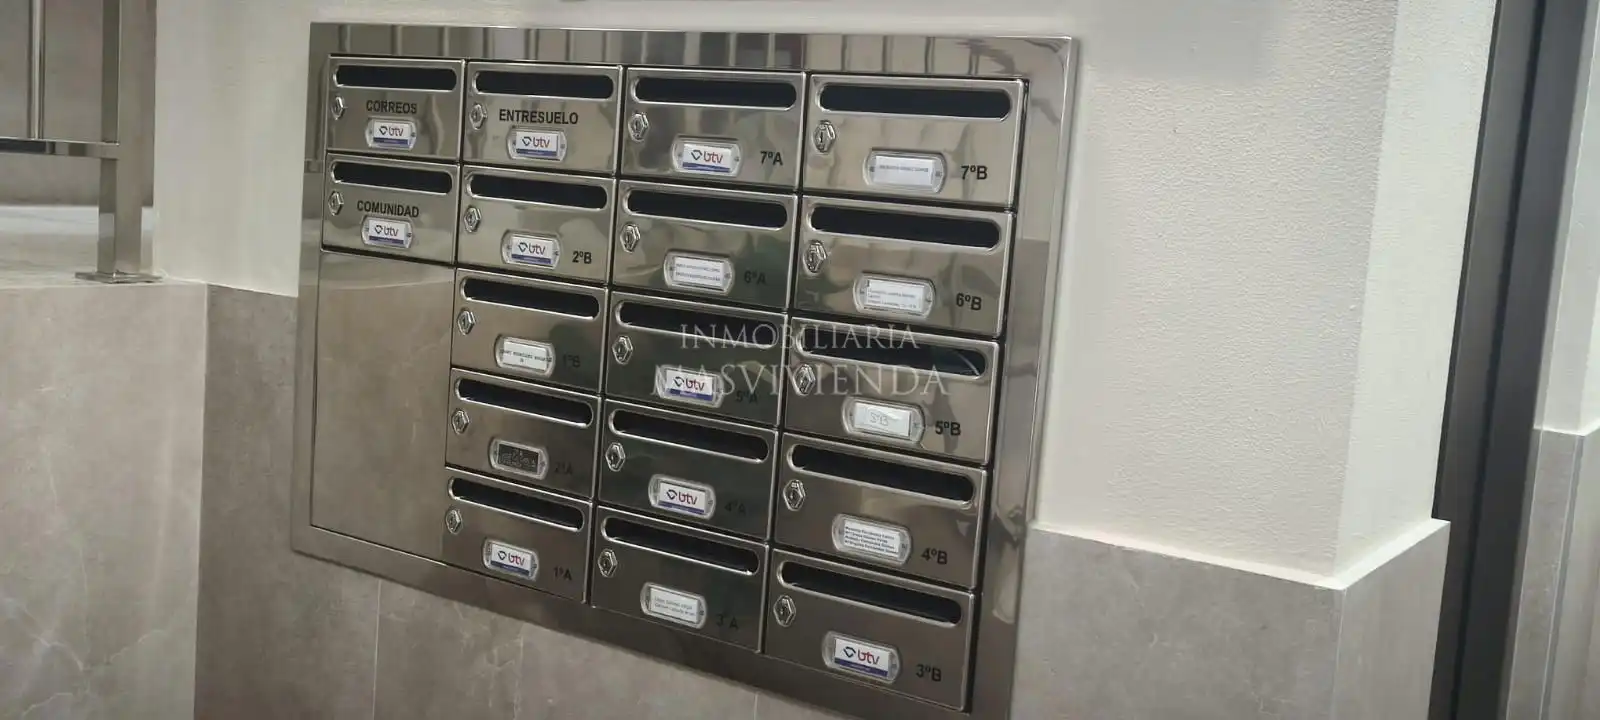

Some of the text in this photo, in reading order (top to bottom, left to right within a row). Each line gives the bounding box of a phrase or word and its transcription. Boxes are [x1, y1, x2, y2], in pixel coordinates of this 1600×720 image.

[366, 100, 417, 114] CORREOS
[499, 109, 578, 125] ENTRESUELO
[388, 125, 404, 137] btv
[533, 136, 550, 148] btv
[703, 151, 723, 164] btv
[760, 151, 783, 166] 7ºA
[960, 165, 988, 180] 7ºB
[357, 200, 419, 218] COMUNIDAD
[383, 225, 399, 237] btv
[528, 243, 546, 255] btv
[572, 250, 592, 264] 2ºB
[956, 292, 982, 311] 6ºB
[935, 420, 962, 436] 5ºB
[678, 491, 697, 505] btv
[508, 552, 525, 566] btv
[921, 547, 948, 565] 4ºB
[857, 649, 880, 665] btv
[916, 664, 942, 682] 3ºB
